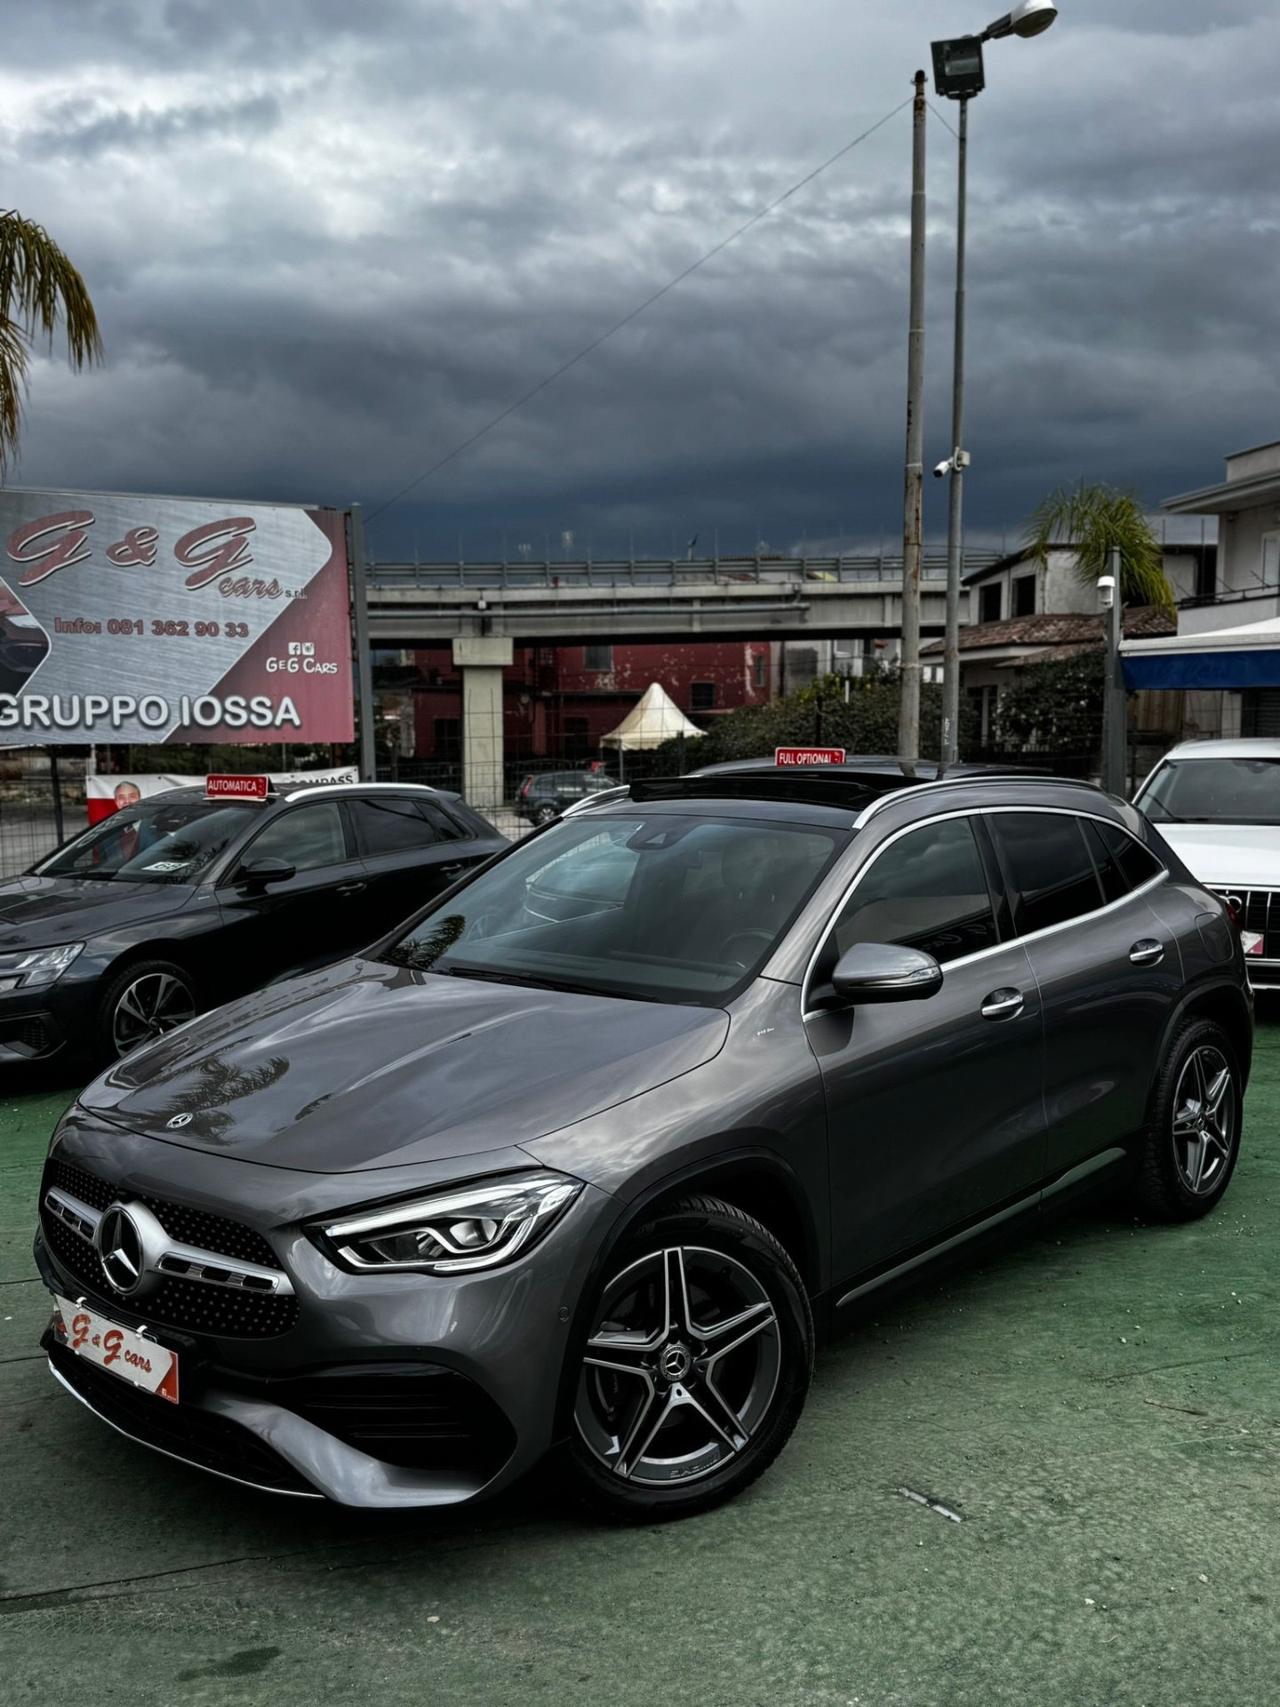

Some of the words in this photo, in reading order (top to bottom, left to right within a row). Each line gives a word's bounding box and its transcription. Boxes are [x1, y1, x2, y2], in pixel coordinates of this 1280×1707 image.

[7, 510, 96, 586] G
[106, 526, 159, 568] &
[174, 517, 257, 591] G
[218, 576, 284, 600] cars
[55, 617, 102, 634] Info:
[107, 618, 145, 636] 081
[151, 619, 190, 637] 362
[194, 621, 219, 638] 90
[224, 622, 250, 638] 33
[0, 693, 169, 727] GRUPPO
[181, 695, 301, 727] IOSSA
[779, 752, 796, 764] FULL
[207, 780, 257, 792] AUTOMATICA
[72, 1313, 91, 1348] G
[103, 1329, 124, 1365] G
[124, 1349, 153, 1373] cars
